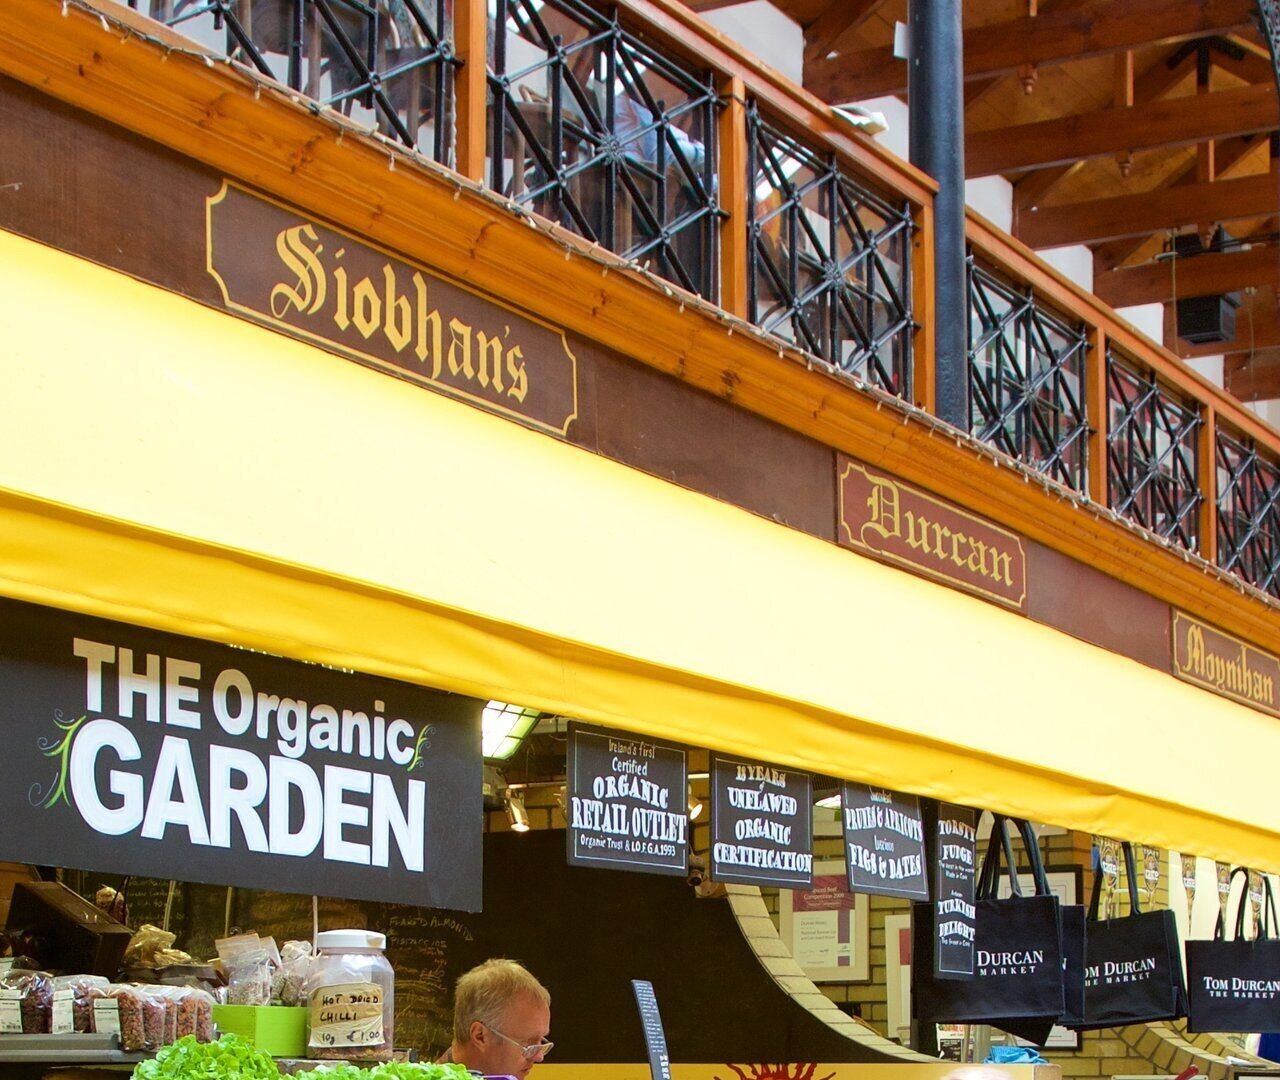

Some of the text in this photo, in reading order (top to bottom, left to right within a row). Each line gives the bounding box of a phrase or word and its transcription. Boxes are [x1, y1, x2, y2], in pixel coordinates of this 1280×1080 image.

[270, 224, 528, 402] Siobhan's
[861, 477, 1014, 588] Durcan
[1183, 625, 1274, 704] Moynihan
[73, 637, 415, 766] THE Organic
[612, 757, 647, 776] Certified
[747, 765, 786, 788] YEARS
[69, 719, 425, 872] GARDEN
[593, 773, 668, 809] ORGANIC
[571, 797, 686, 844] RETAIL OUTLET
[735, 818, 791, 845] ORGANIC
[884, 806, 923, 842] APRICOTS
[580, 834, 606, 849] Organic
[607, 838, 623, 850] Trust
[713, 842, 812, 873] CERTIFICATION
[849, 843, 876, 874] FIGS
[878, 858, 887, 878] &
[889, 854, 921, 880] DATES
[938, 899, 976, 919] TURKISH
[939, 922, 975, 941] DELIGHT
[977, 950, 1043, 967] DURCAN
[1084, 957, 1155, 979] OM DURCAN
[980, 965, 1035, 976] MARKET
[1084, 972, 1151, 987] HE MARKET
[1209, 990, 1275, 999] THE MARKET
[1232, 977, 1280, 991] DURCAN
[321, 994, 380, 1006] HOT DRIED
[320, 1011, 358, 1021] CHILLI
